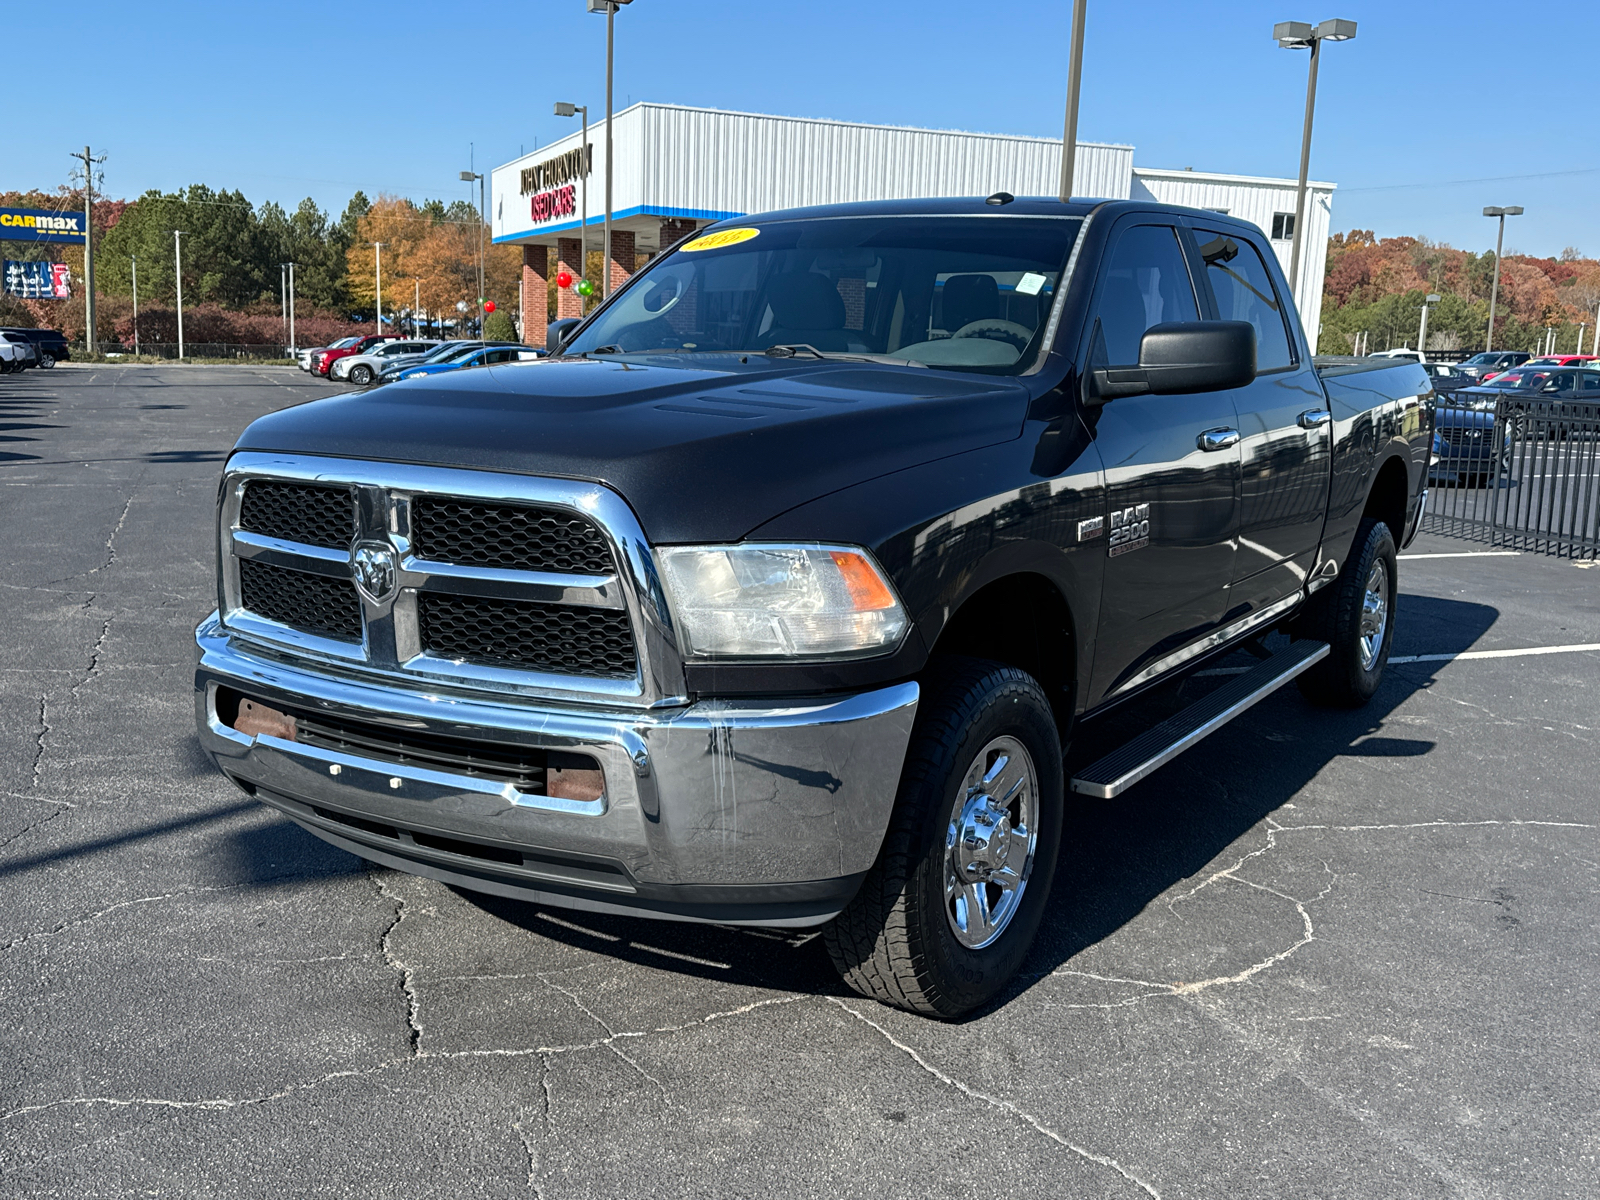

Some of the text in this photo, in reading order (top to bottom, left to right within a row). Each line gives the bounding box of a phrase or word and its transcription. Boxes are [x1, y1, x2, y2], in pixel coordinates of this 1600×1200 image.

[520, 143, 593, 195] JOHN THORNTON
[531, 184, 576, 222] USED CARS
[1110, 503, 1149, 529] RAM
[1109, 520, 1149, 546] 2500
